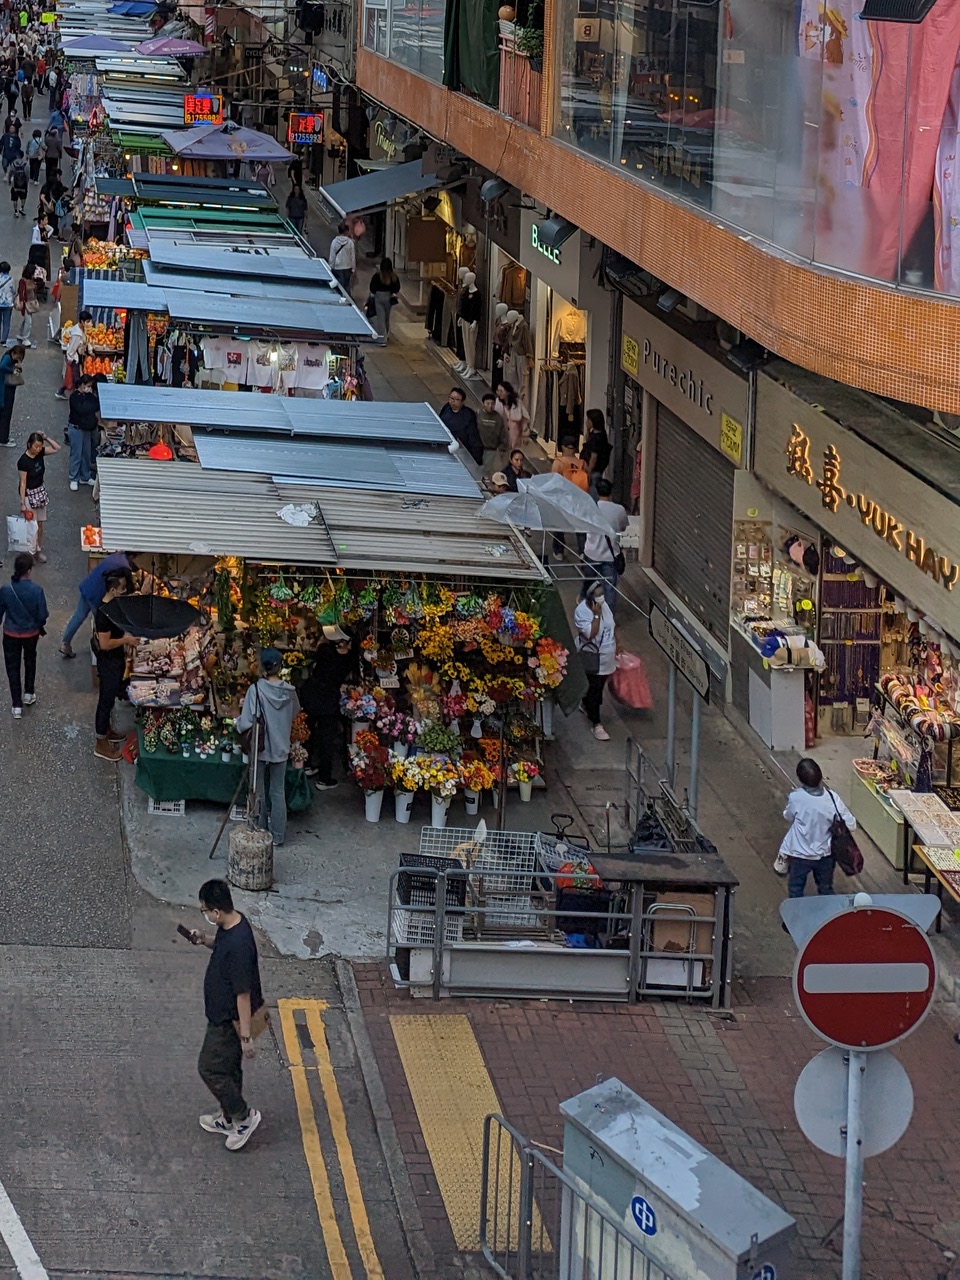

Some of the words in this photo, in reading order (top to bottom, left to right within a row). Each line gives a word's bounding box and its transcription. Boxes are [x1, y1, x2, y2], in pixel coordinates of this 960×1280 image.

[643, 338, 714, 415] Purechic
[857, 493, 904, 552] YUK
[906, 530, 959, 591] HAY
